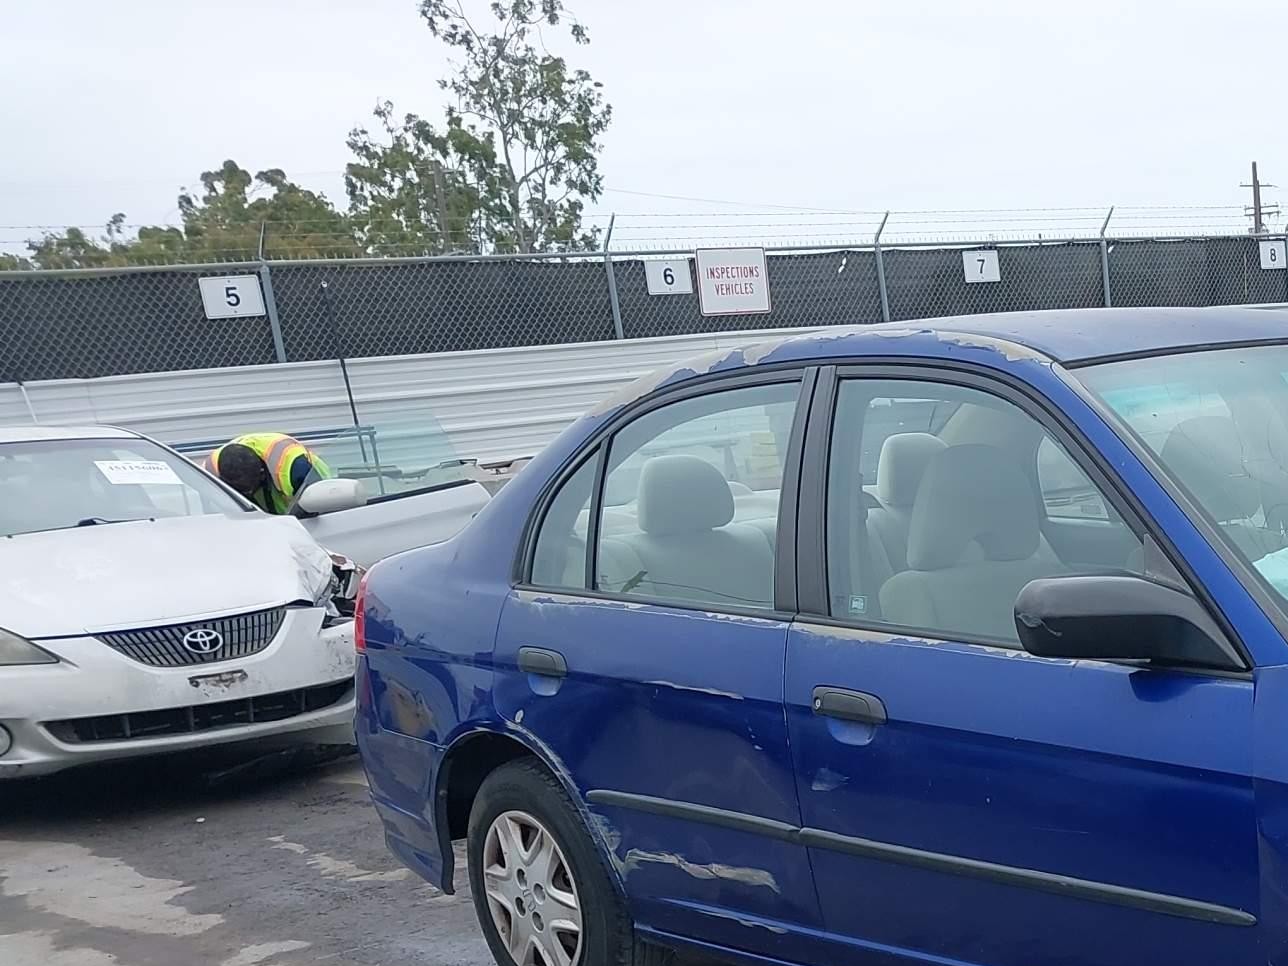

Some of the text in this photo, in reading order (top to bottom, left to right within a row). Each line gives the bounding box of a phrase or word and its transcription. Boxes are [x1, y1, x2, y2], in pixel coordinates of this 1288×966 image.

[1269, 248, 1277, 262] 8
[706, 265, 760, 279] INSPECTIONS
[976, 259, 985, 274] 7
[663, 267, 675, 285] 6
[225, 286, 241, 307] 5
[715, 283, 754, 296] VEHICLES
